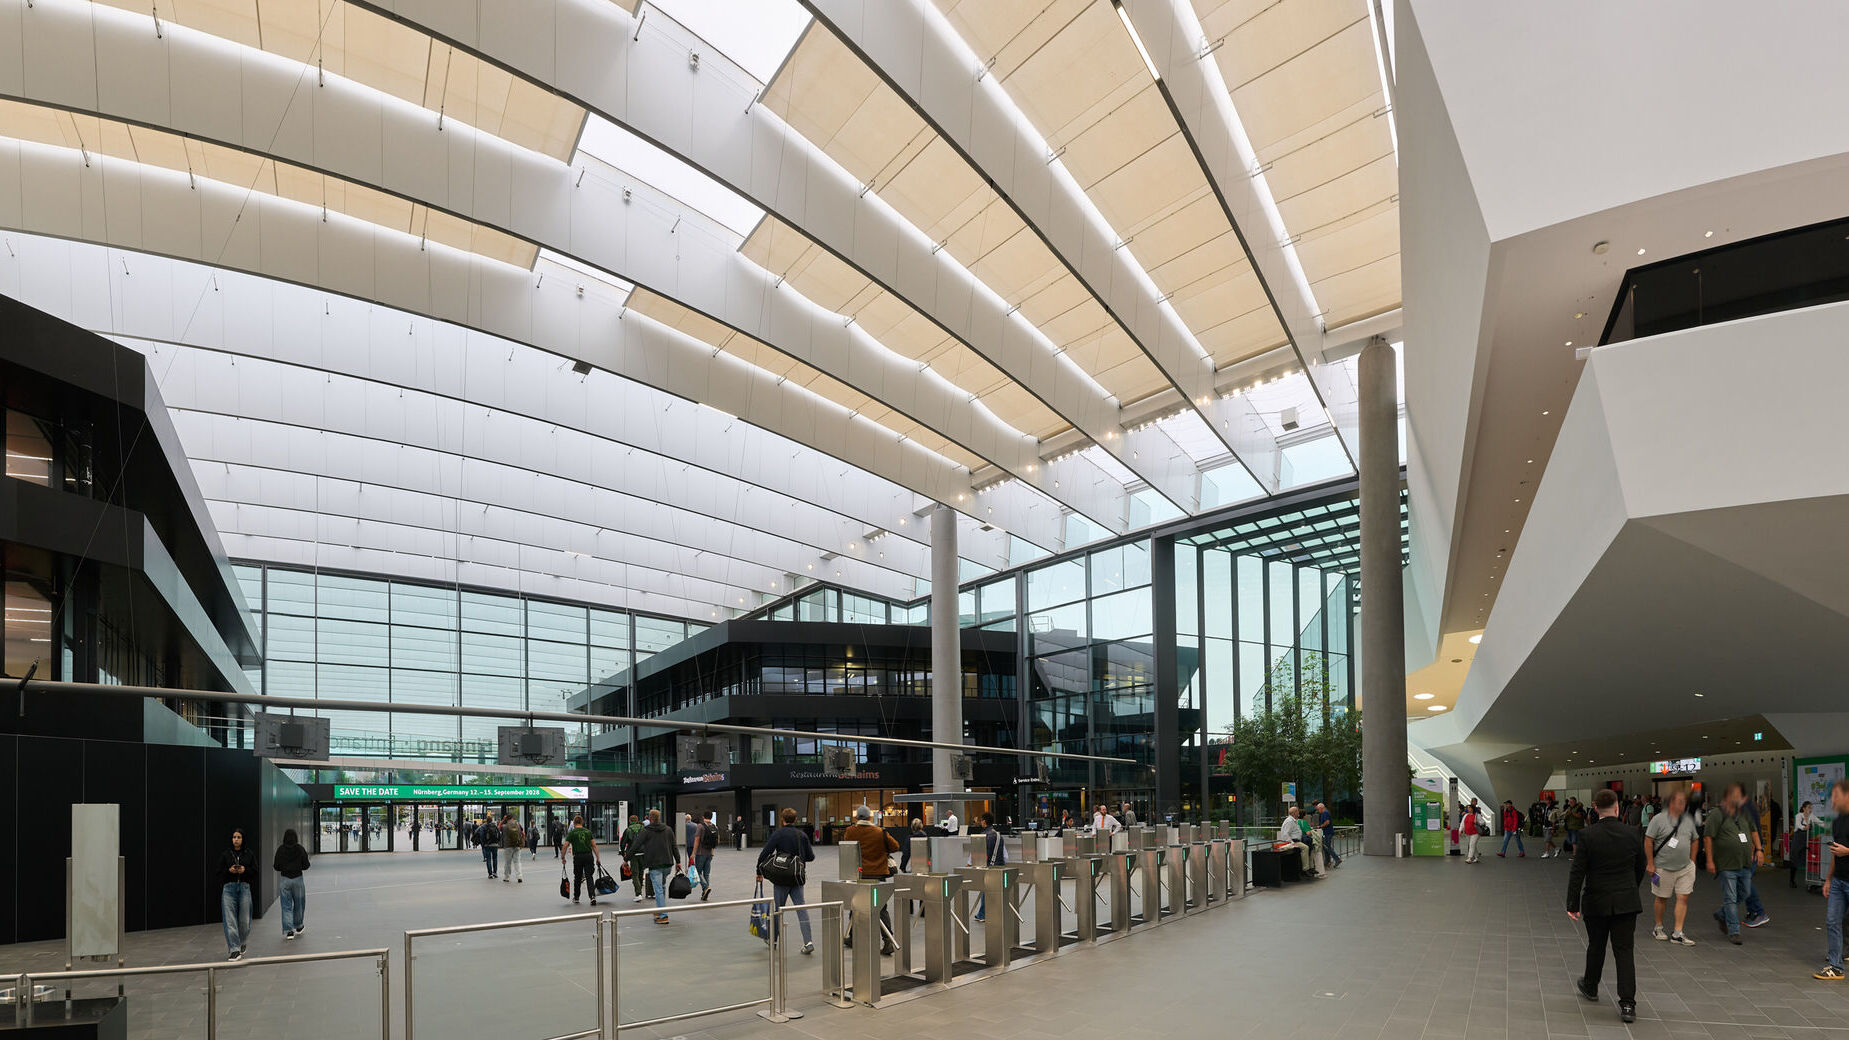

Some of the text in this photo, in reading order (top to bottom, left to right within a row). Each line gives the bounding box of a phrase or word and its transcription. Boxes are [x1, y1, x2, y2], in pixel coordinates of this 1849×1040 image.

[339, 787, 360, 796] SAVE
[361, 787, 377, 796] THE
[378, 787, 399, 796] DATE
[494, 788, 524, 798] September
